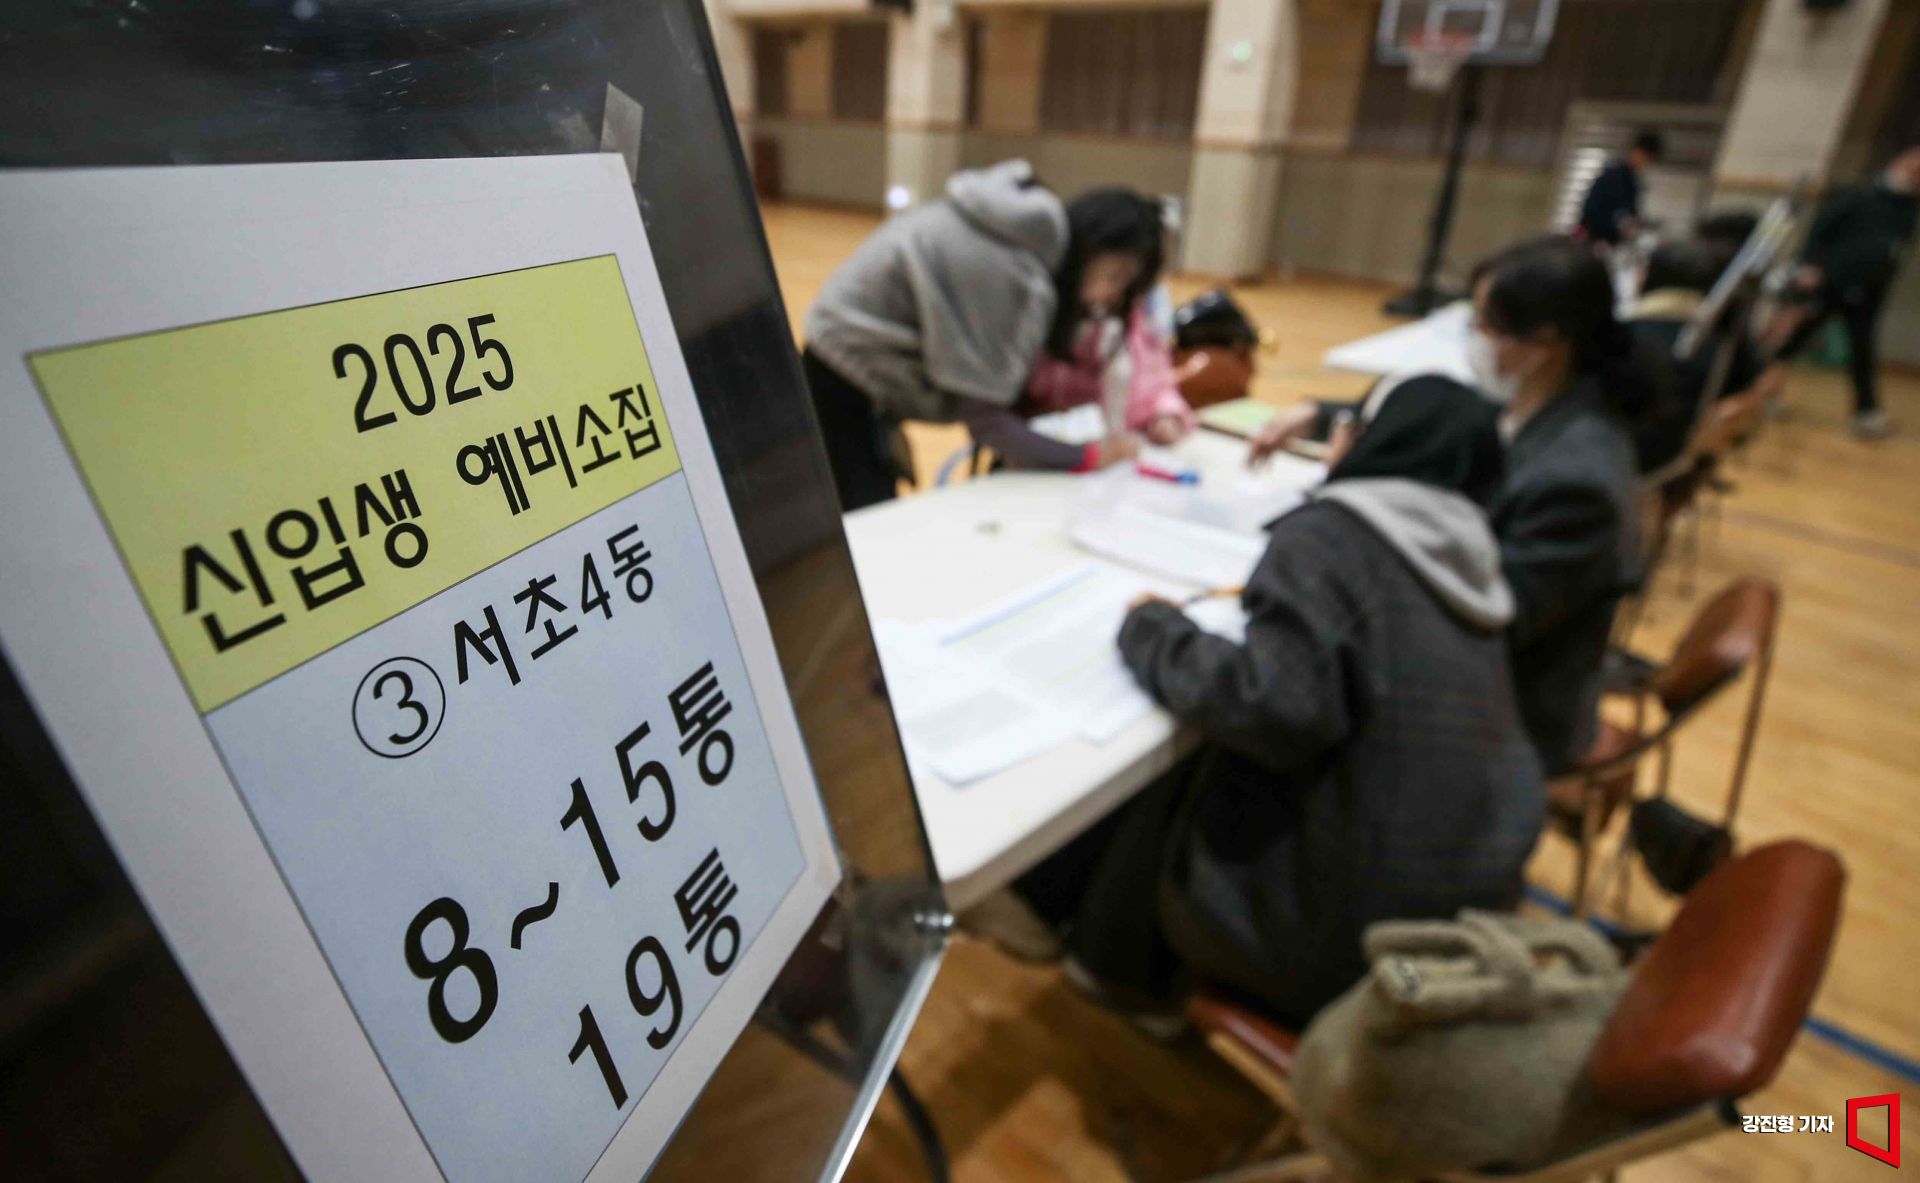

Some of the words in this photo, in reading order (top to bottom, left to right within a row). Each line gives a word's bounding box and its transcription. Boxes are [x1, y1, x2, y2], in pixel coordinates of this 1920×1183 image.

[332, 312, 514, 434] 2025
[180, 468, 430, 655] 신입생
[455, 382, 663, 517] 예비소집
[566, 846, 742, 1112] 19통
